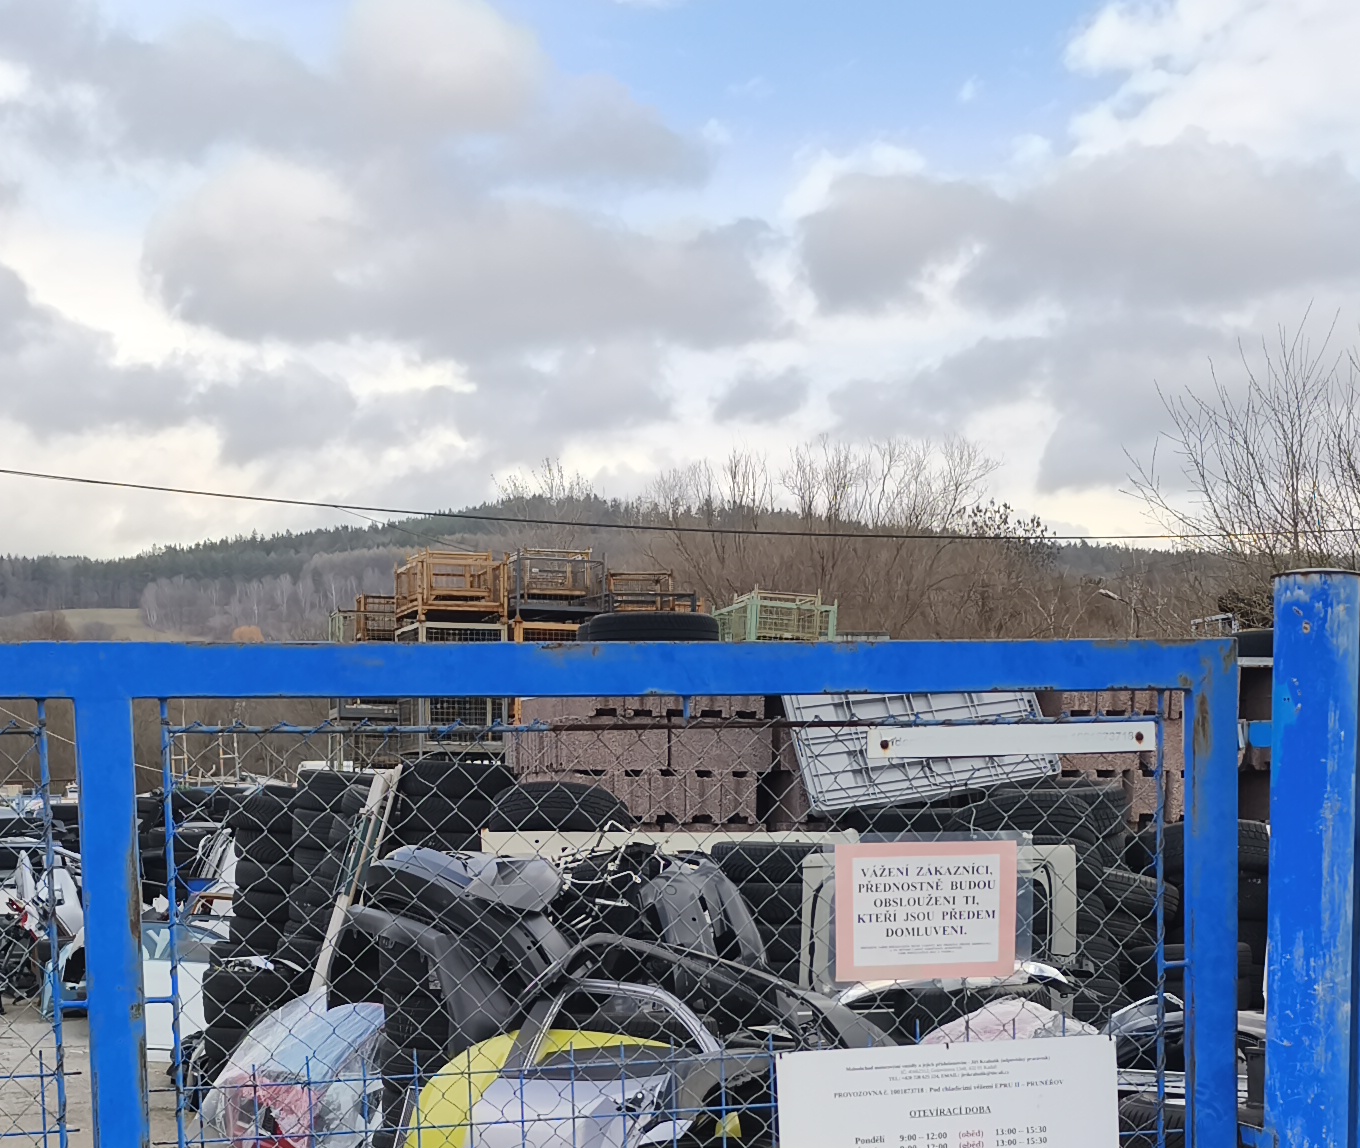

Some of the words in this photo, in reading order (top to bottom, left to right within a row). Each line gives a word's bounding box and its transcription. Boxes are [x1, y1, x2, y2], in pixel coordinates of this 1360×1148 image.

[861, 864, 909, 878] VÁŽENÍ
[916, 863, 993, 877] ZÁKAZNÍCI,
[858, 879, 944, 893] PŘEDNOSTNĚ
[950, 879, 996, 891] BUDOU
[873, 895, 957, 908] OBSLOUŽENI
[963, 896, 980, 907] TI,
[857, 910, 897, 924] KTEŘÍ
[903, 911, 935, 922] JSOU
[941, 908, 996, 921] PŘEDEM
[885, 925, 968, 938] DOMLUVENI.
[834, 1090, 883, 1099] PROVOZOVNA
[909, 1105, 963, 1118] OTEVÍRACÍ
[965, 1106, 991, 1116] DOBA
[899, 1134, 917, 1142] 9:00
[926, 1132, 947, 1140] 12:00
[958, 1130, 984, 1139] (oběd)
[995, 1128, 1017, 1136] 13:00
[1026, 1126, 1047, 1134] 15:30
[996, 1139, 1017, 1147] 13:00
[1026, 1137, 1048, 1145] 15:30
